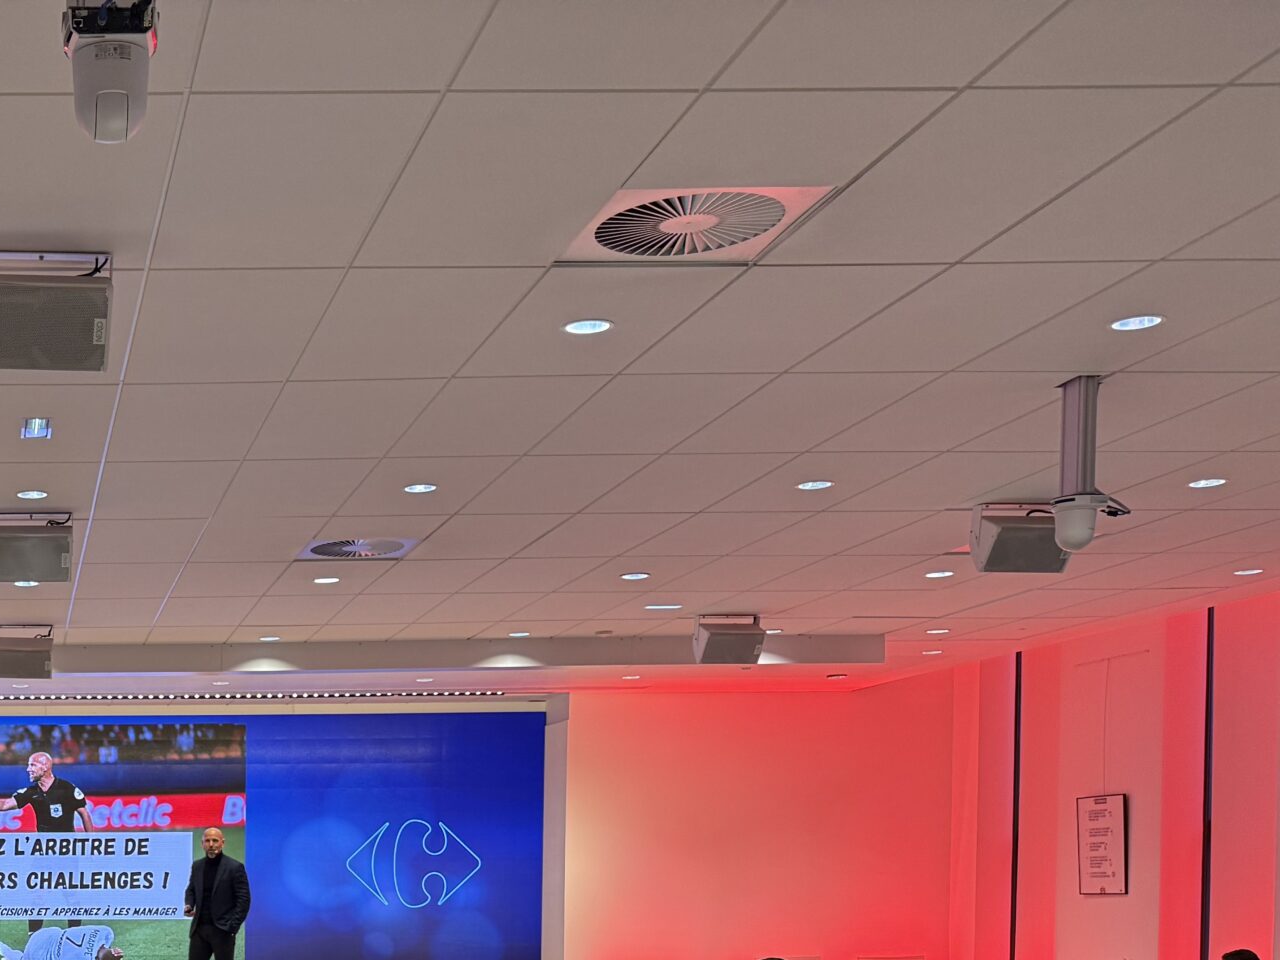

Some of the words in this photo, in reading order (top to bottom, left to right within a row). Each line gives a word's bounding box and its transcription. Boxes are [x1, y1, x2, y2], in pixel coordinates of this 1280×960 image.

[14, 836, 116, 856] L'ARBITRE
[124, 837, 150, 856] DE
[26, 871, 154, 890] CHALLENGES
[36, 907, 50, 916] ET
[52, 907, 101, 916] APPRENEZ
[103, 905, 111, 916] À
[113, 907, 131, 916] LES
[132, 907, 178, 916] MANAGER
[65, 933, 86, 948] 7
